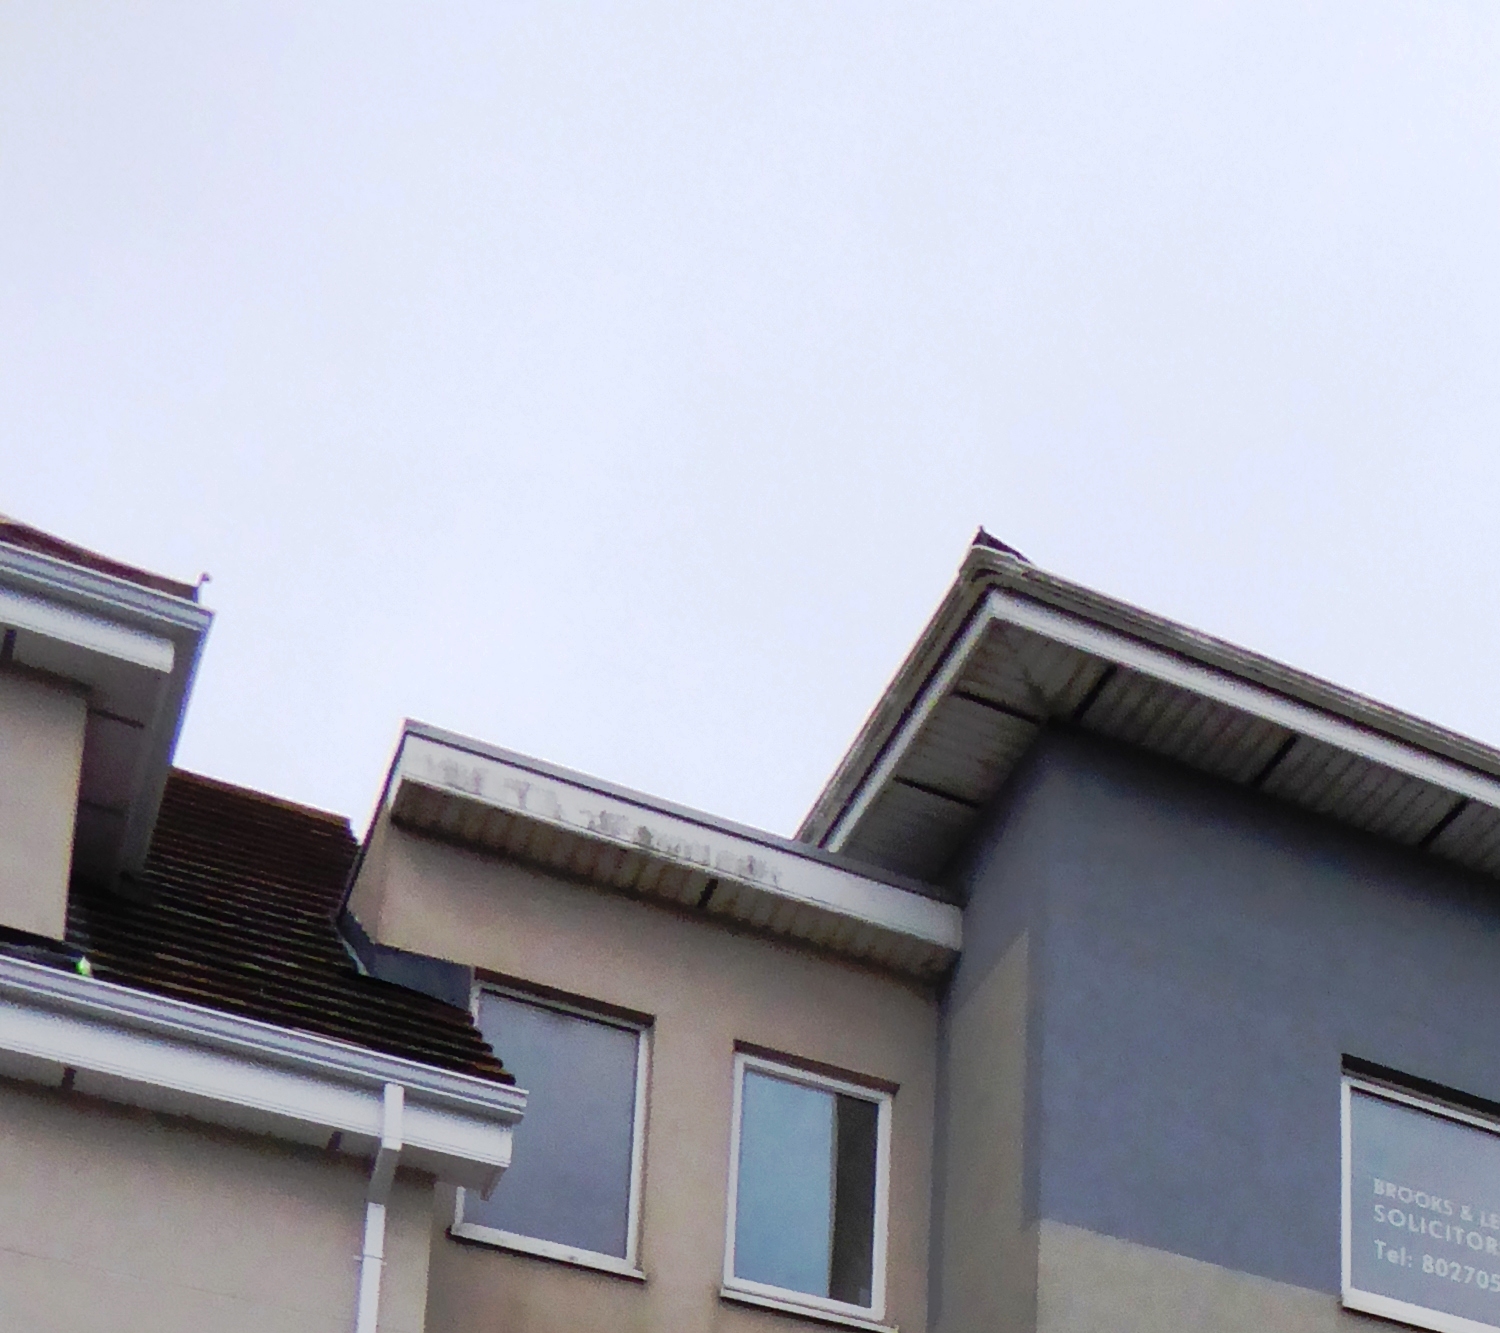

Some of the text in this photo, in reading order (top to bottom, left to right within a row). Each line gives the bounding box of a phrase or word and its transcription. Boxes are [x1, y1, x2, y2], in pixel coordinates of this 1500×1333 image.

[1373, 1178, 1453, 1216] BROOKS
[1460, 1205, 1473, 1222] &
[1374, 1238, 1413, 1268] Tel:
